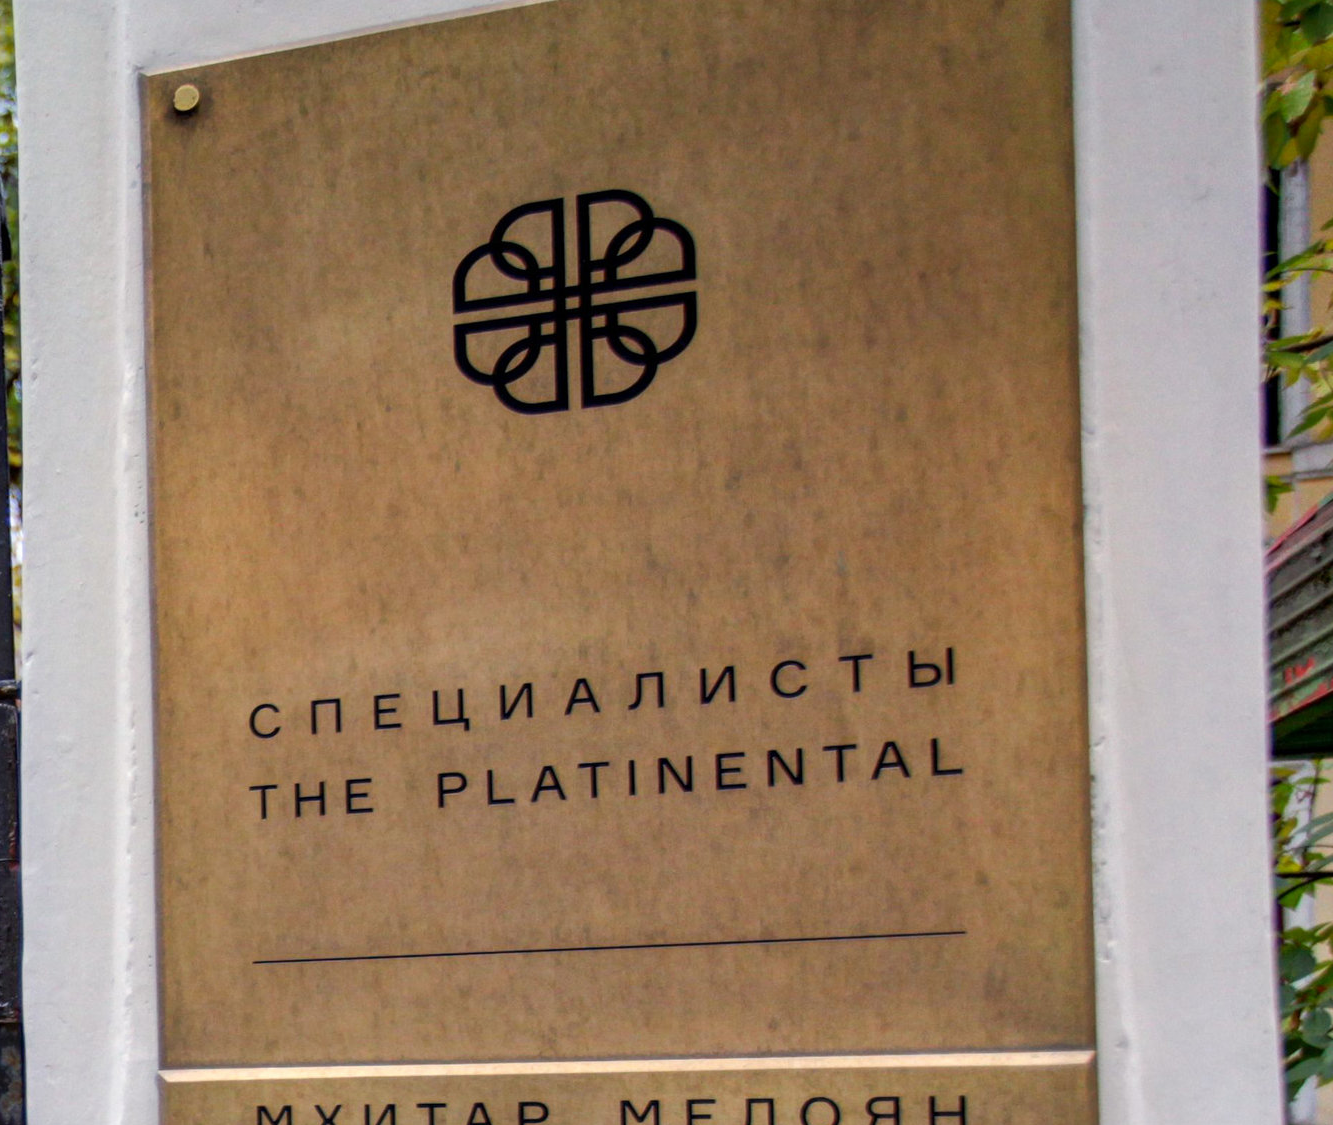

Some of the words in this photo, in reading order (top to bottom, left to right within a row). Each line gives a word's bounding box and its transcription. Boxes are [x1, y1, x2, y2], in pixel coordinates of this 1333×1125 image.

[248, 646, 956, 740] СПЕЦИАЛИСТЫ
[248, 777, 375, 821] THE
[436, 736, 964, 810] PLATINENTAL
